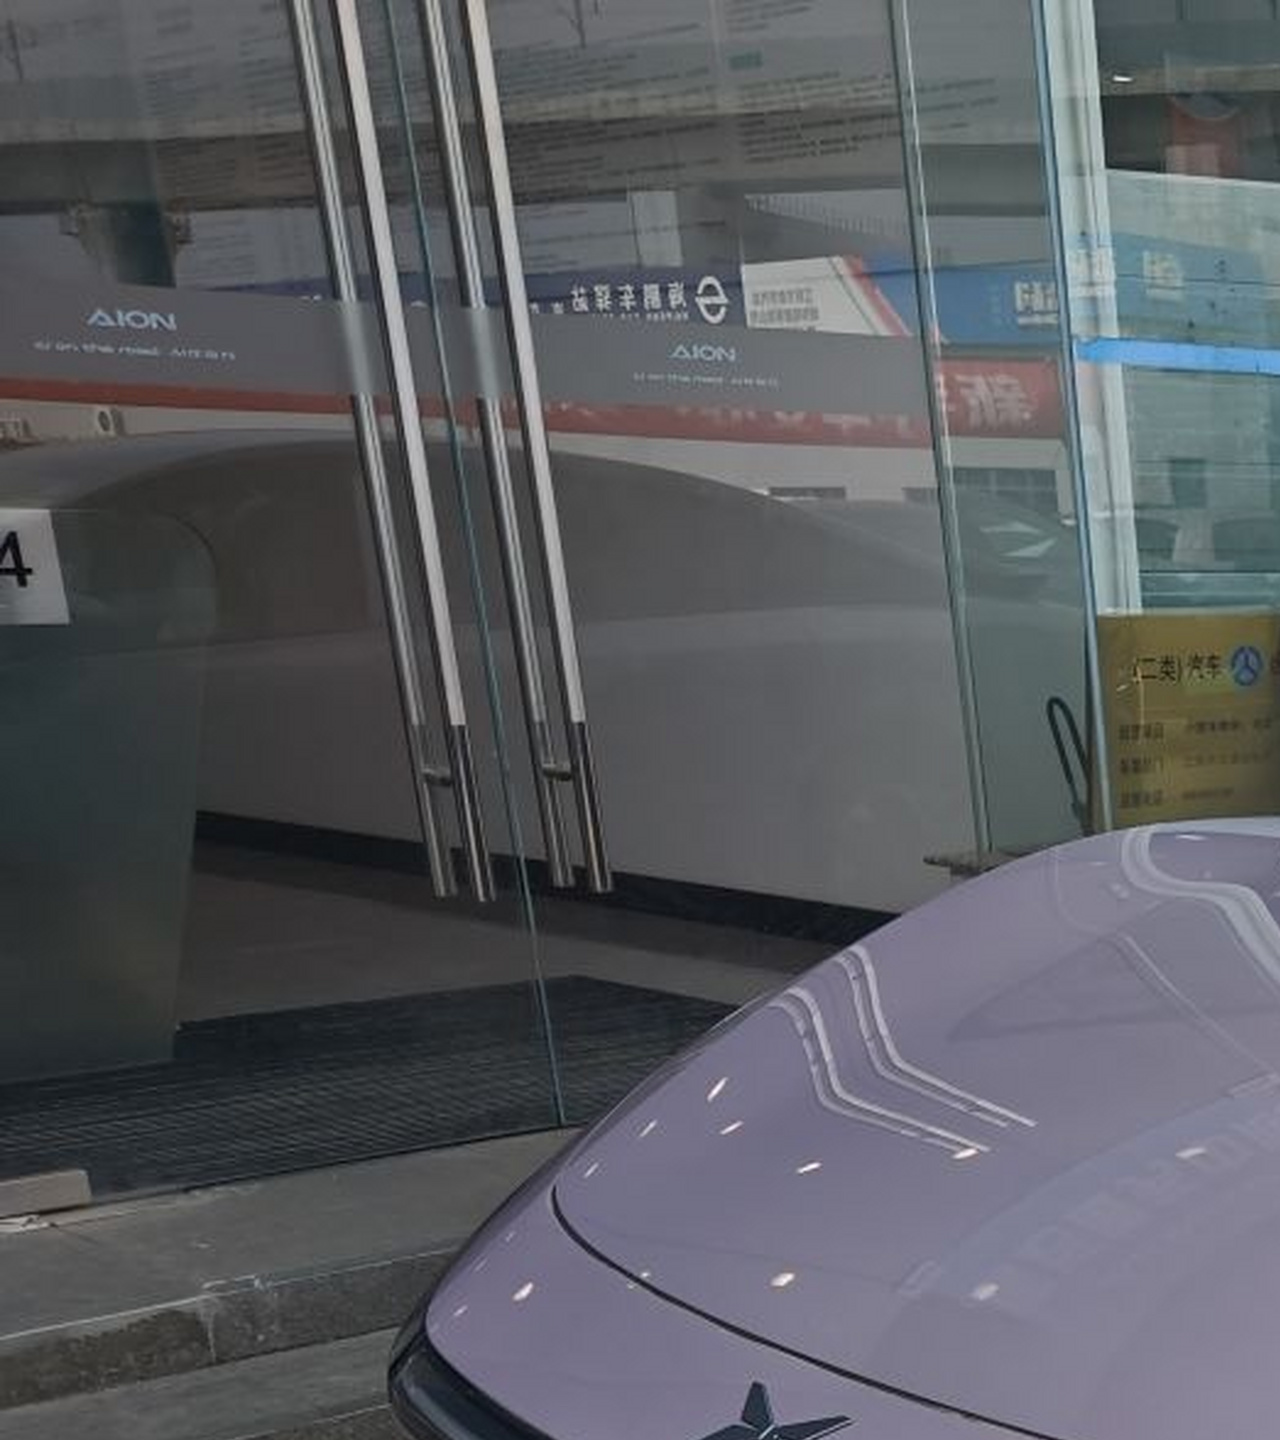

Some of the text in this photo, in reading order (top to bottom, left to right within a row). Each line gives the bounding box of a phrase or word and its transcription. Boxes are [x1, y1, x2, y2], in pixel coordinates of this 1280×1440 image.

[86, 308, 178, 331] AION
[669, 344, 736, 361] AION
[0, 531, 33, 588] 4
